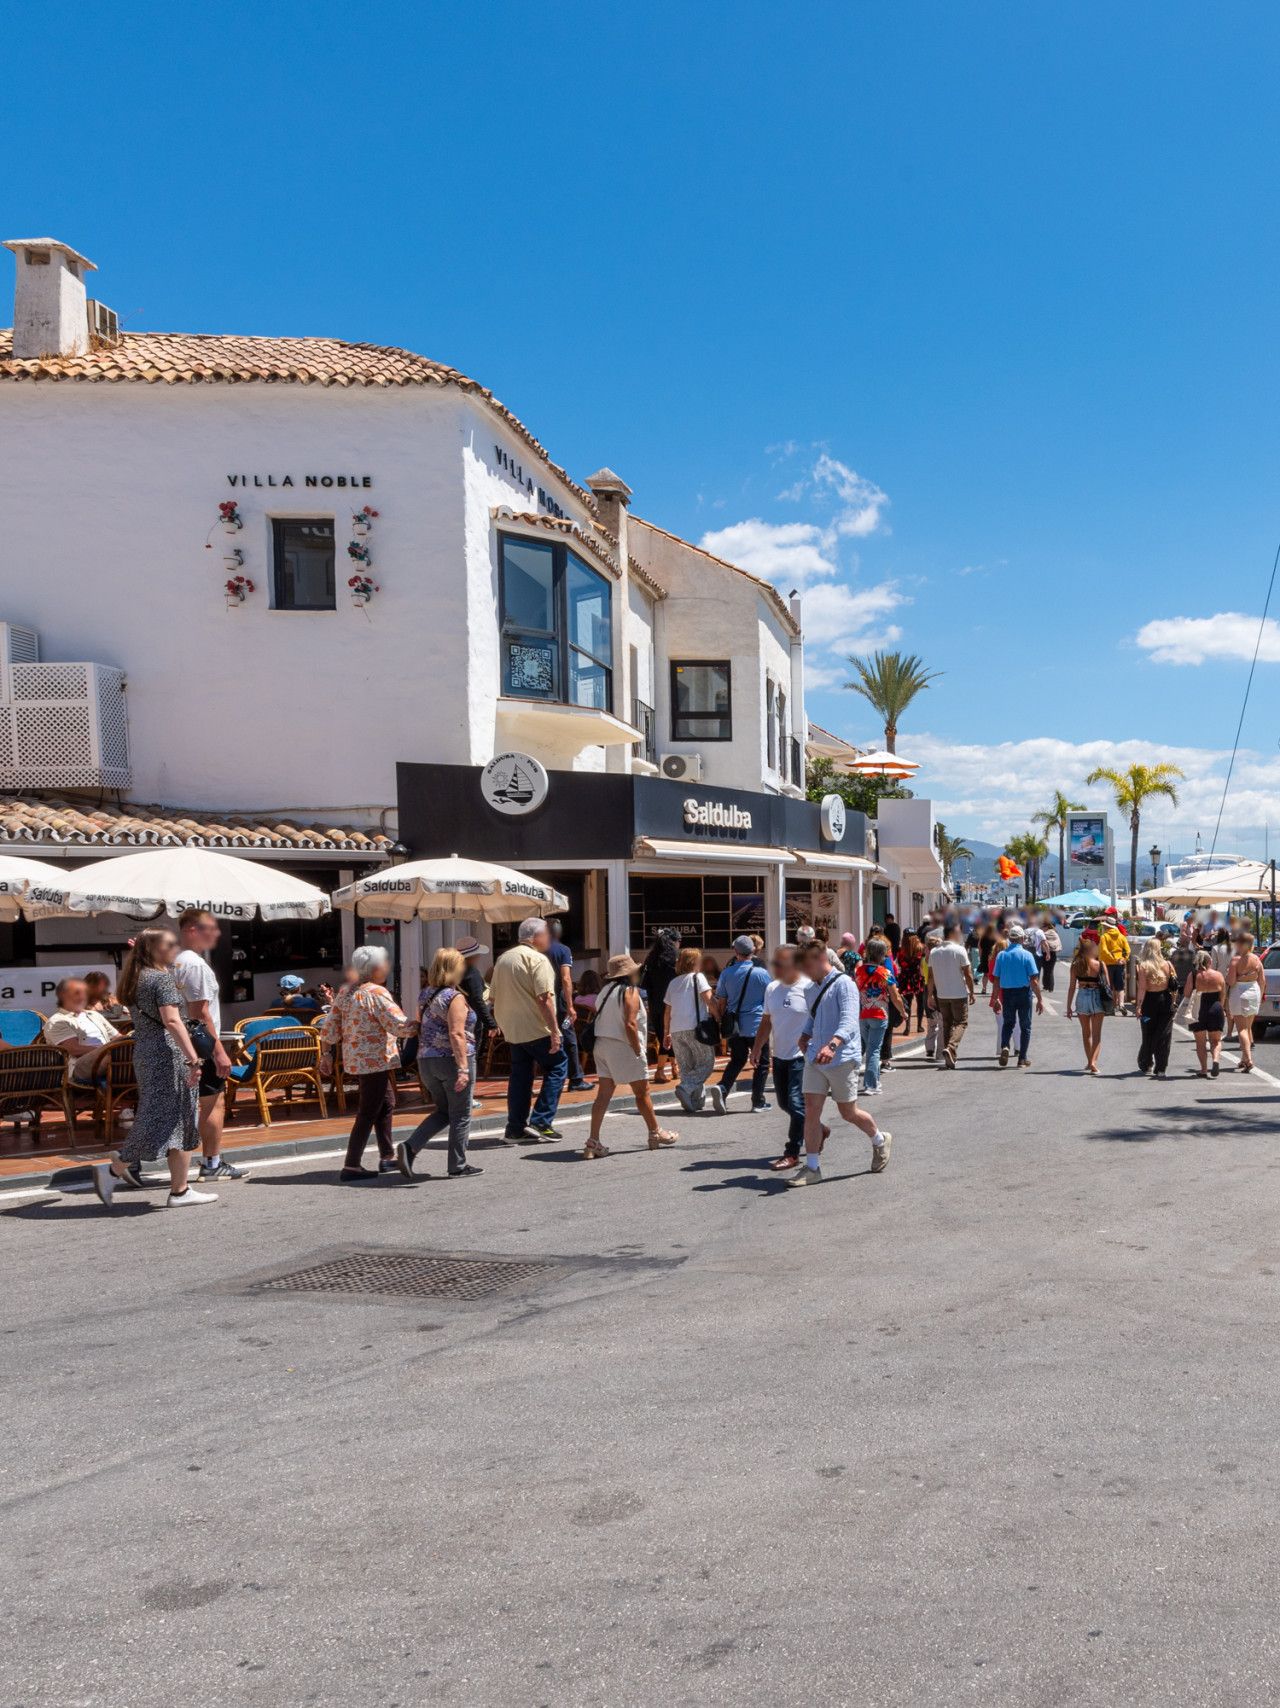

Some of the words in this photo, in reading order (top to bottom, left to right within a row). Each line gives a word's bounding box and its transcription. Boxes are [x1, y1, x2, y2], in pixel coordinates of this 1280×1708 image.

[494, 445, 534, 496] VILLA
[227, 475, 294, 487] VILLA
[305, 476, 371, 487] NOBLE
[487, 754, 515, 774] SALDUBA
[527, 759, 538, 774] PUB
[683, 798, 752, 829] Salduba
[363, 879, 411, 893] Salduba
[504, 880, 545, 899] Salduba
[30, 887, 63, 905] Salduba
